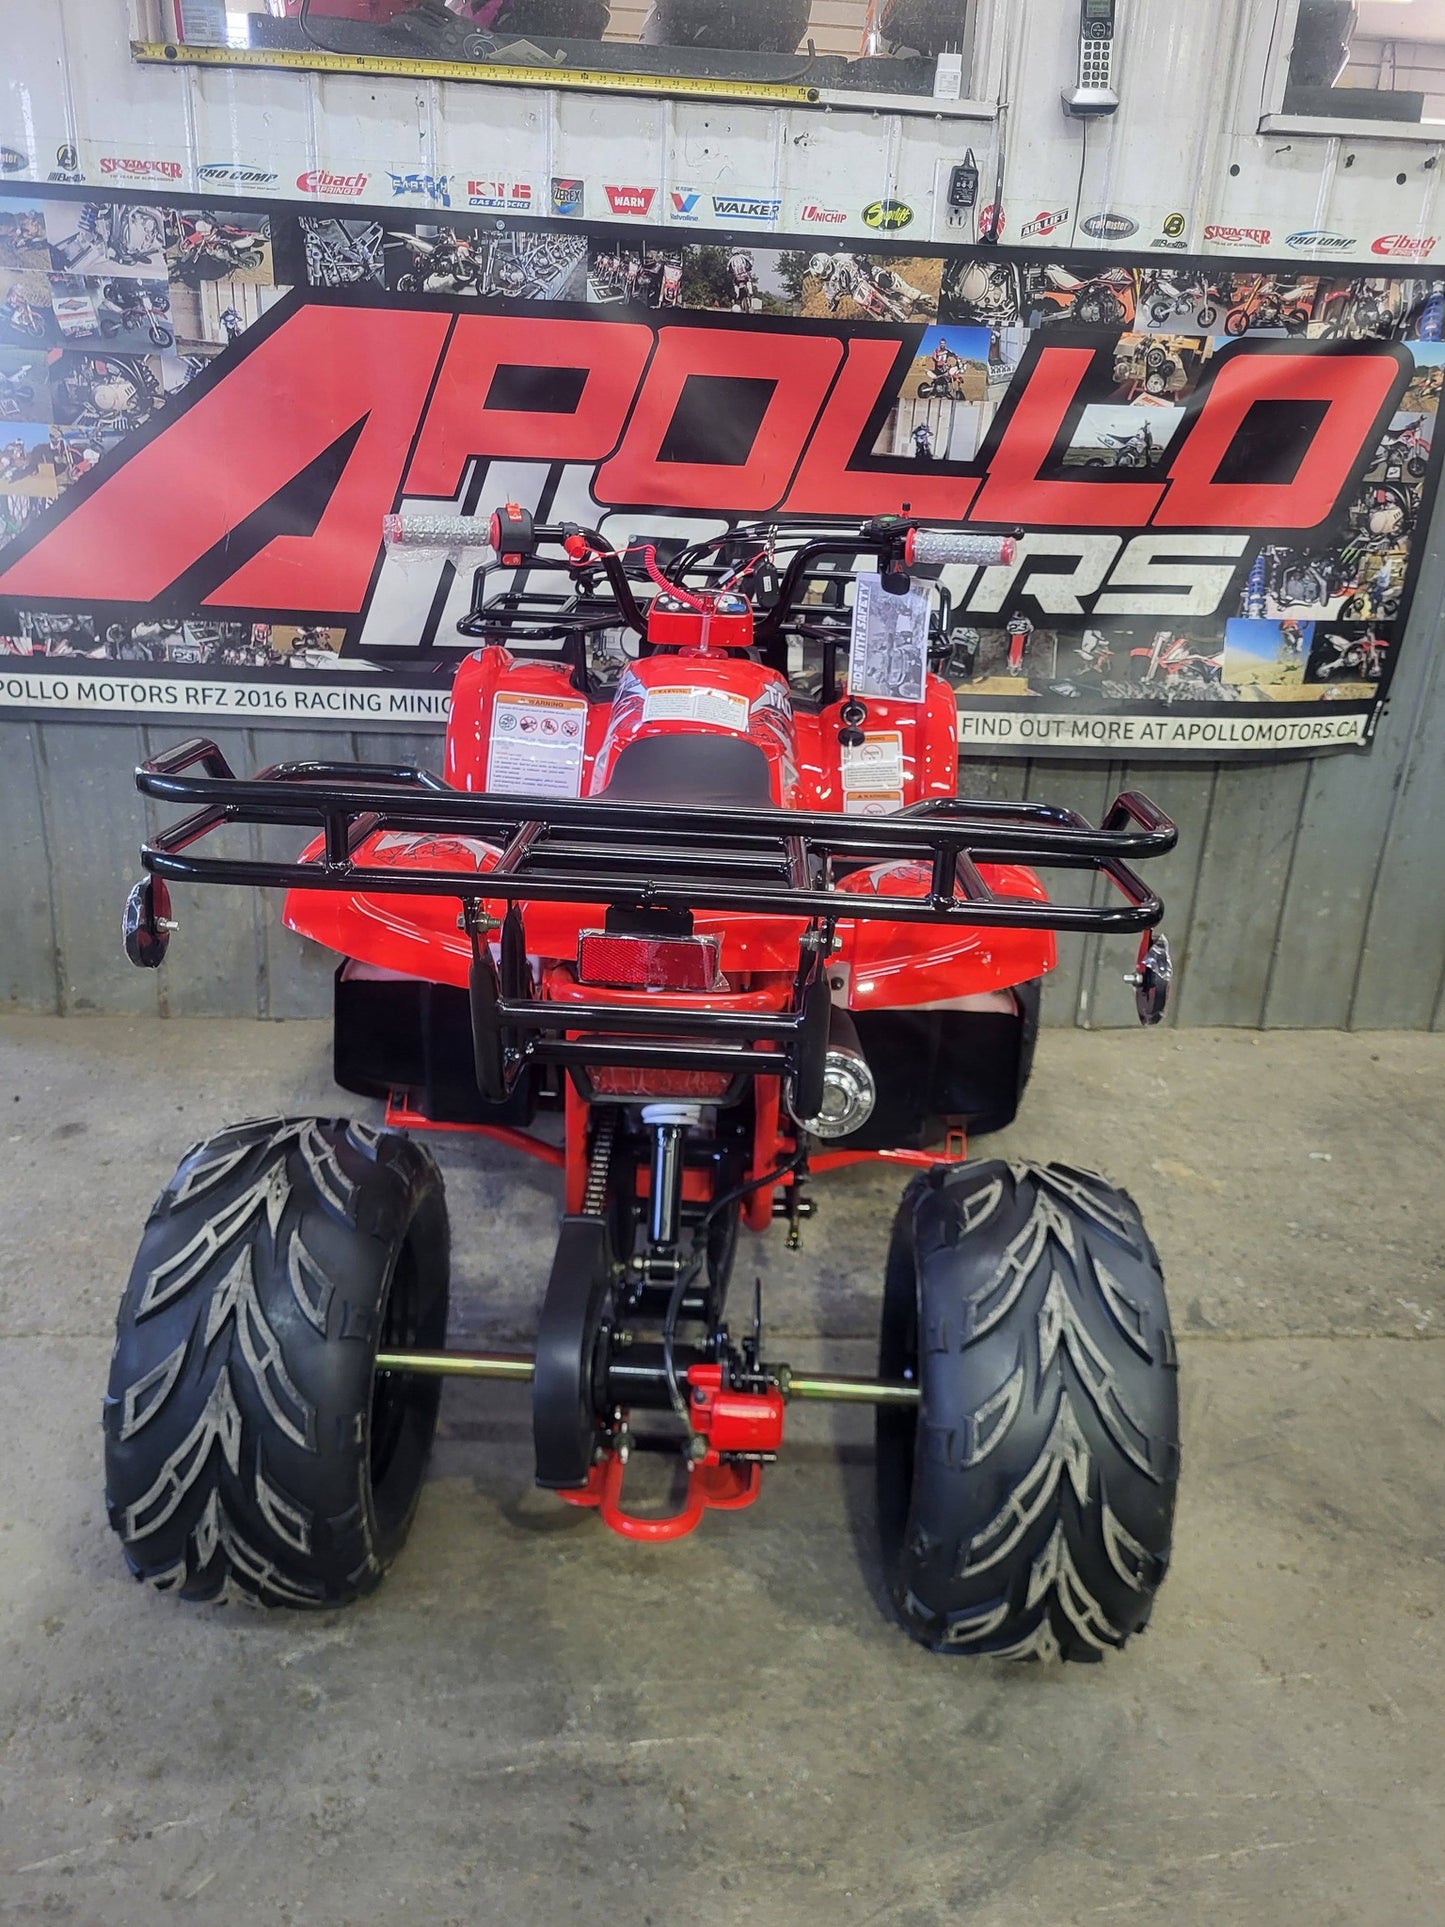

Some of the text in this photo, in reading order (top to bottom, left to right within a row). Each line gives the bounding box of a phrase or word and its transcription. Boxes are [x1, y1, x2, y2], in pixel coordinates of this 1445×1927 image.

[100, 158, 183, 178] SKYJACKER
[229, 170, 278, 182] COMP
[318, 187, 361, 196] PRINGS
[467, 181, 531, 198] KYB
[553, 186, 581, 203] ZEREX
[470, 199, 529, 209] GAS SHOCKS
[614, 196, 645, 208] WARN
[712, 196, 780, 216] WALKER
[671, 214, 699, 222] Valvoline
[801, 206, 847, 223] UNICHIP
[1022, 210, 1068, 237] AIR LIFT
[1203, 226, 1271, 244] SKYJACKER
[1286, 235, 1315, 245] PRO
[0, 303, 1409, 612] APOLLO
[852, 583, 870, 692] RIDE WITH SAFETY
[77, 682, 178, 705] MOTORS
[186, 687, 229, 707] RFZ
[234, 688, 288, 709] 2016
[295, 691, 382, 712] RACING
[529, 699, 564, 708] WARNING
[962, 717, 1359, 742] FIND OUT MORE AT APOLLOMOTORS.CA
